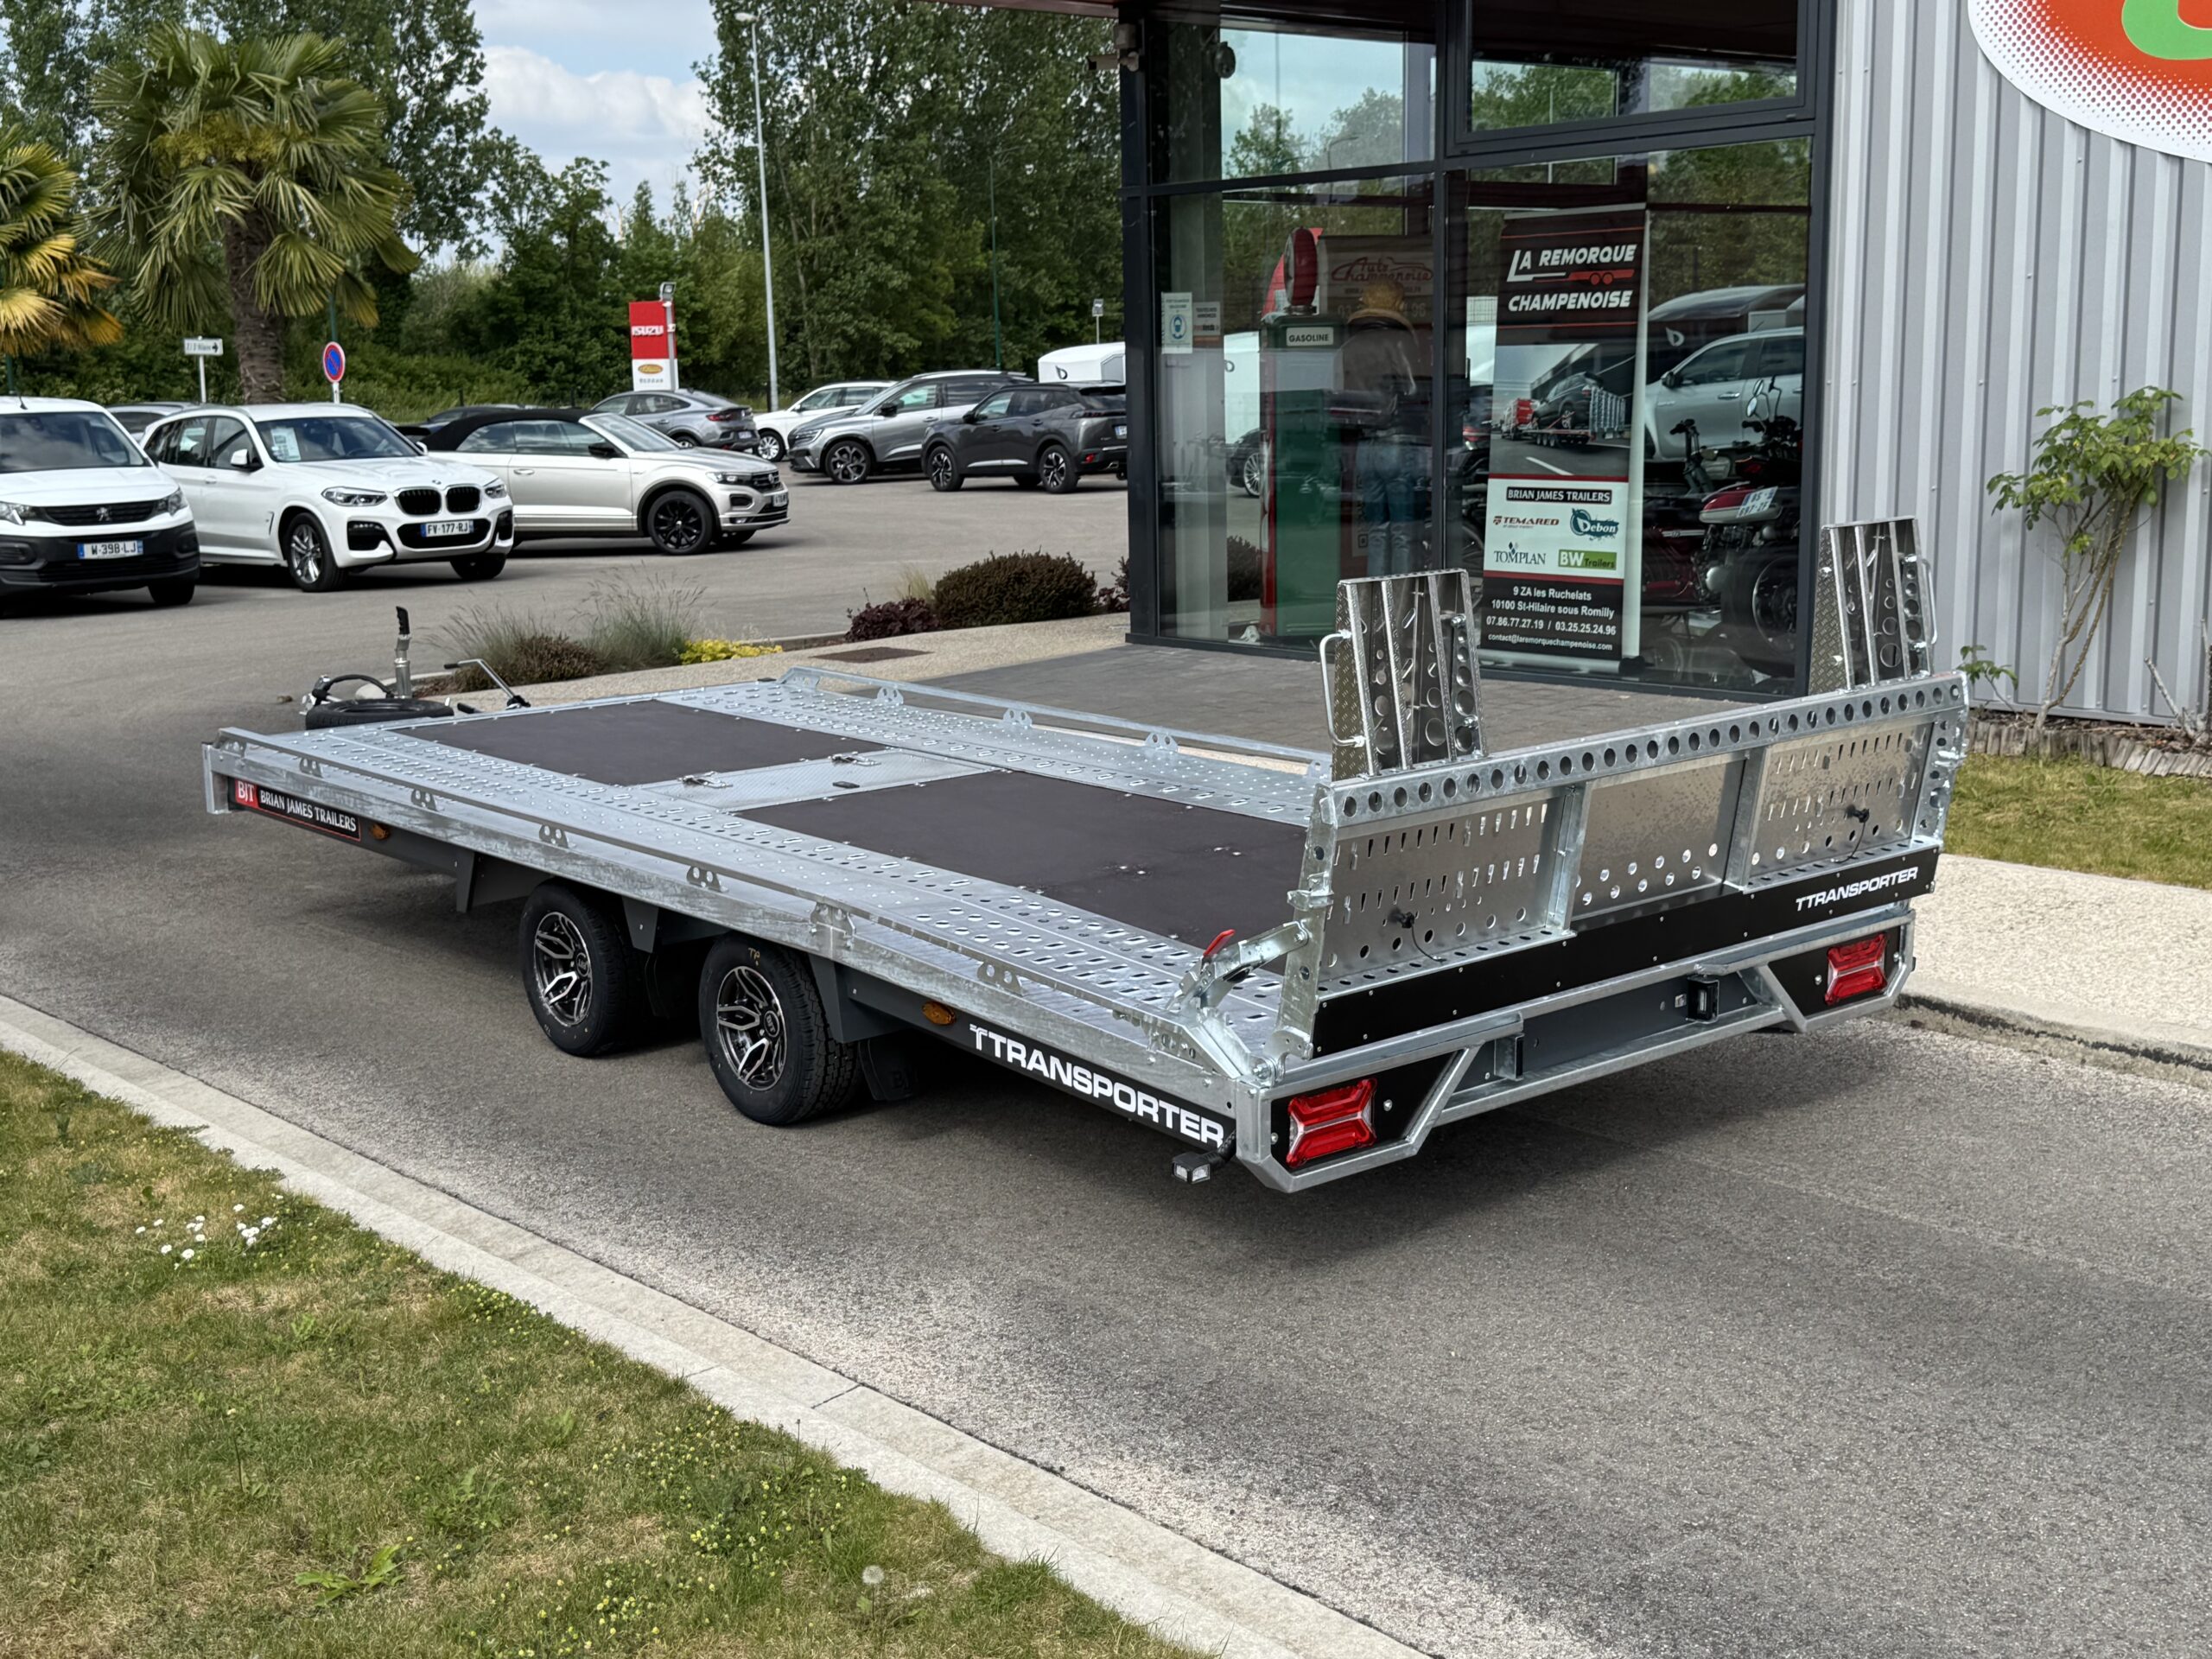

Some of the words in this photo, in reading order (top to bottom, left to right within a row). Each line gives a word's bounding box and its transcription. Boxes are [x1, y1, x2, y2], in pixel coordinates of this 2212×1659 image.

[1539, 245, 1637, 267] REMORQUE
[1508, 290, 1633, 312] CHAMPENOISE
[632, 325, 664, 336] ISUZU
[1288, 334, 1329, 342] GASOLINE
[1508, 489, 1535, 499] BRIAN
[1535, 490, 1564, 501] JAMES
[1566, 492, 1611, 502] TRAILERS
[1503, 517, 1560, 525] TEMARED
[1578, 517, 1617, 534] Debon
[1494, 550, 1546, 564] TOMPLAN
[1560, 551, 1585, 567] BW
[1584, 558, 1615, 569] Trailers
[1513, 586, 1519, 595] 9
[1520, 587, 1532, 597] ZA
[1534, 588, 1546, 598] les
[1548, 588, 1592, 601] Ruchelats
[1491, 600, 1516, 610] 10100
[1516, 601, 1555, 613] St-Hilaire
[1557, 607, 1579, 615] sous
[1580, 606, 1615, 620] Romilly
[1486, 616, 1544, 630] 07.86.77.27.19
[1554, 621, 1617, 636] 03.25.25.24.96
[1488, 633, 1612, 651] contact@laremorquechampenoise.com
[238, 781, 255, 802] BJT
[260, 791, 285, 810] BRIAN
[286, 798, 313, 819] JAMES
[314, 806, 357, 832] TRAILERS
